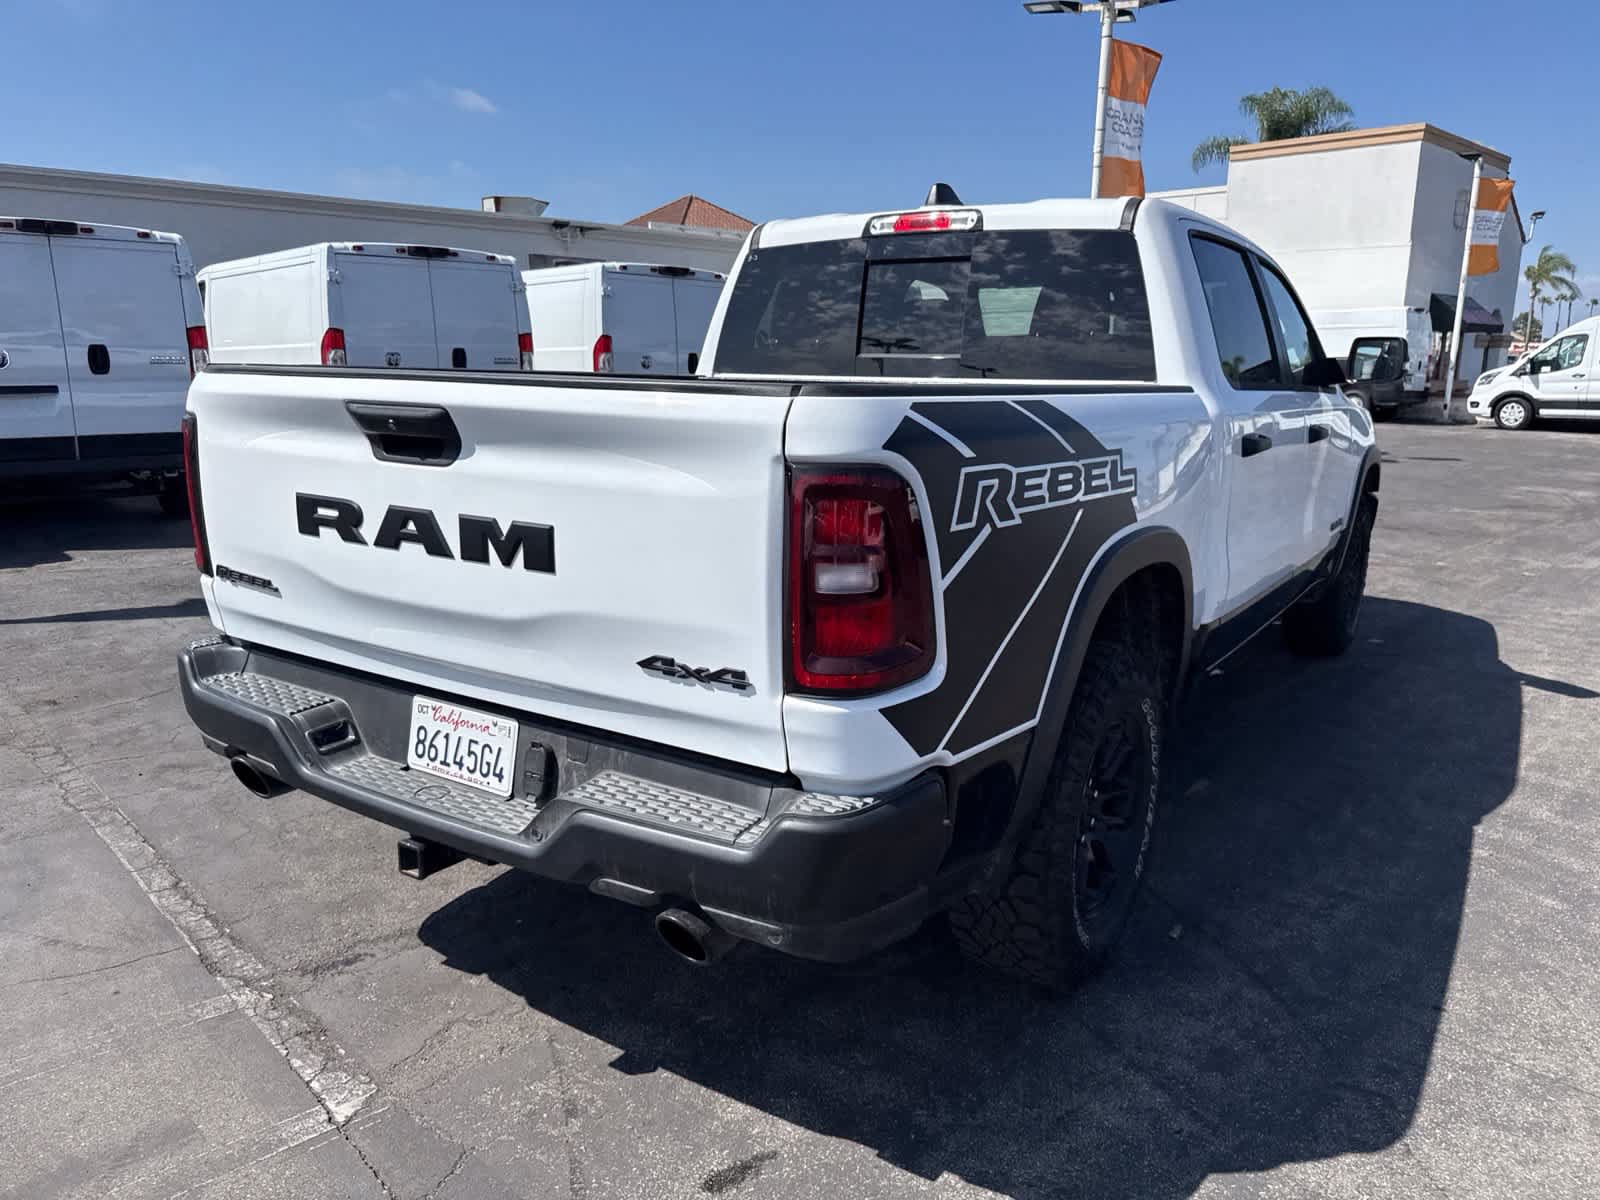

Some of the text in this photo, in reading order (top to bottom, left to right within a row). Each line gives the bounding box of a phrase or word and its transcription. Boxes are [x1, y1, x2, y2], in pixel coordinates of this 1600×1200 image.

[949, 454, 1135, 533] REBEL
[295, 491, 557, 576] RAM
[216, 564, 279, 592] REBEL
[417, 704, 429, 715] OCT
[432, 706, 497, 736] California
[415, 725, 505, 783] 86145G4
